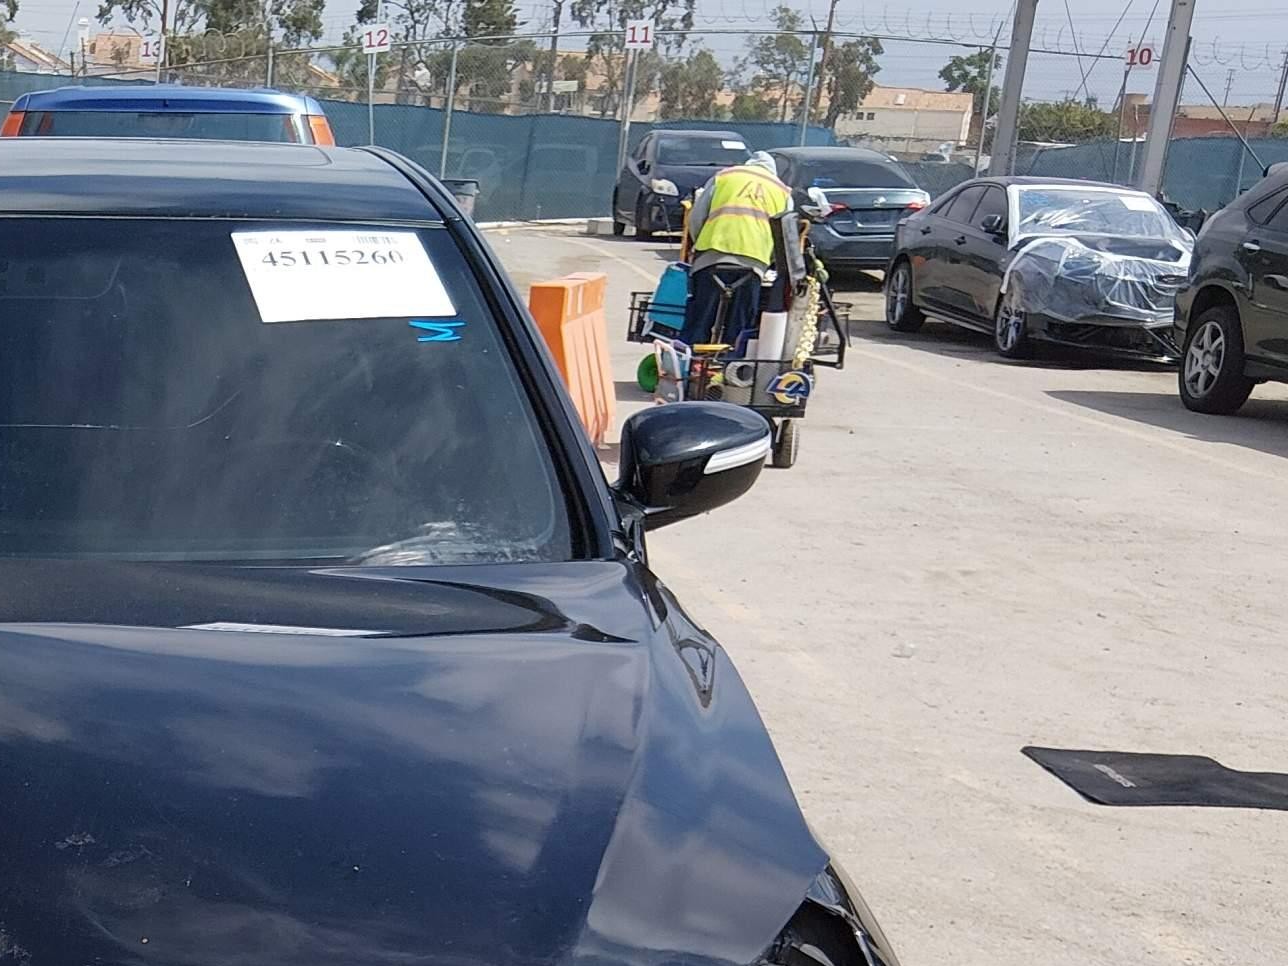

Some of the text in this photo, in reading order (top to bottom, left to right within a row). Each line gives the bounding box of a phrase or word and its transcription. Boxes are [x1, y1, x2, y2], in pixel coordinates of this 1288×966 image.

[365, 29, 389, 48] 12
[627, 26, 651, 43] 11
[141, 40, 161, 57] 13
[1125, 47, 1152, 66] 10
[261, 249, 404, 267] 45115260
